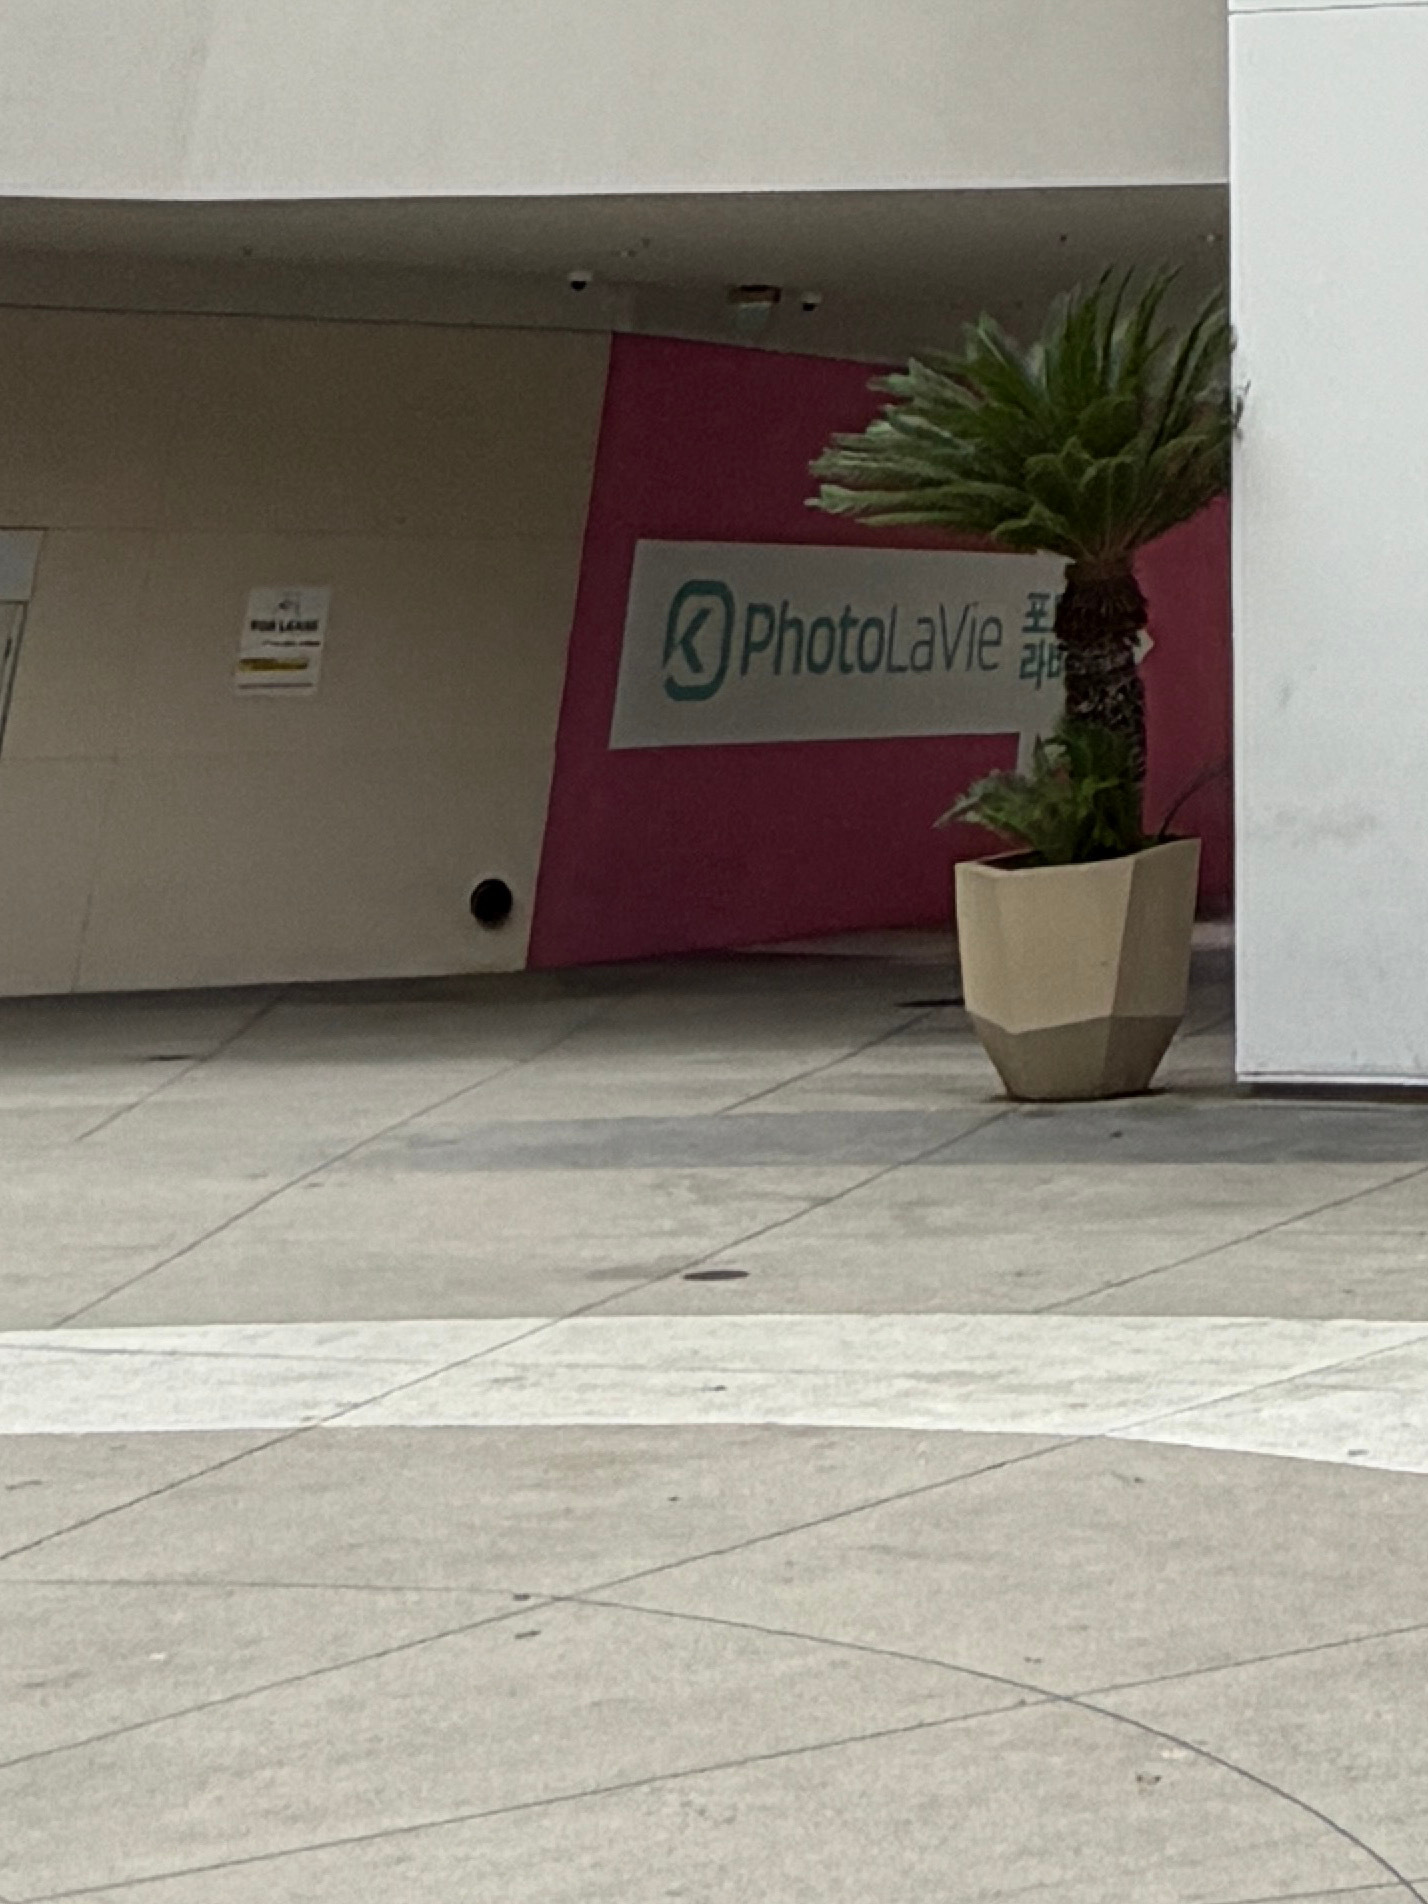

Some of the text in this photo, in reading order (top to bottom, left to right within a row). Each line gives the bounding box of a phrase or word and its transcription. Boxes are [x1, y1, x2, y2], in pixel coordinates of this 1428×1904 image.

[250, 619, 319, 633] FOR LEASE
[739, 599, 1004, 676] PhotoLaVie
